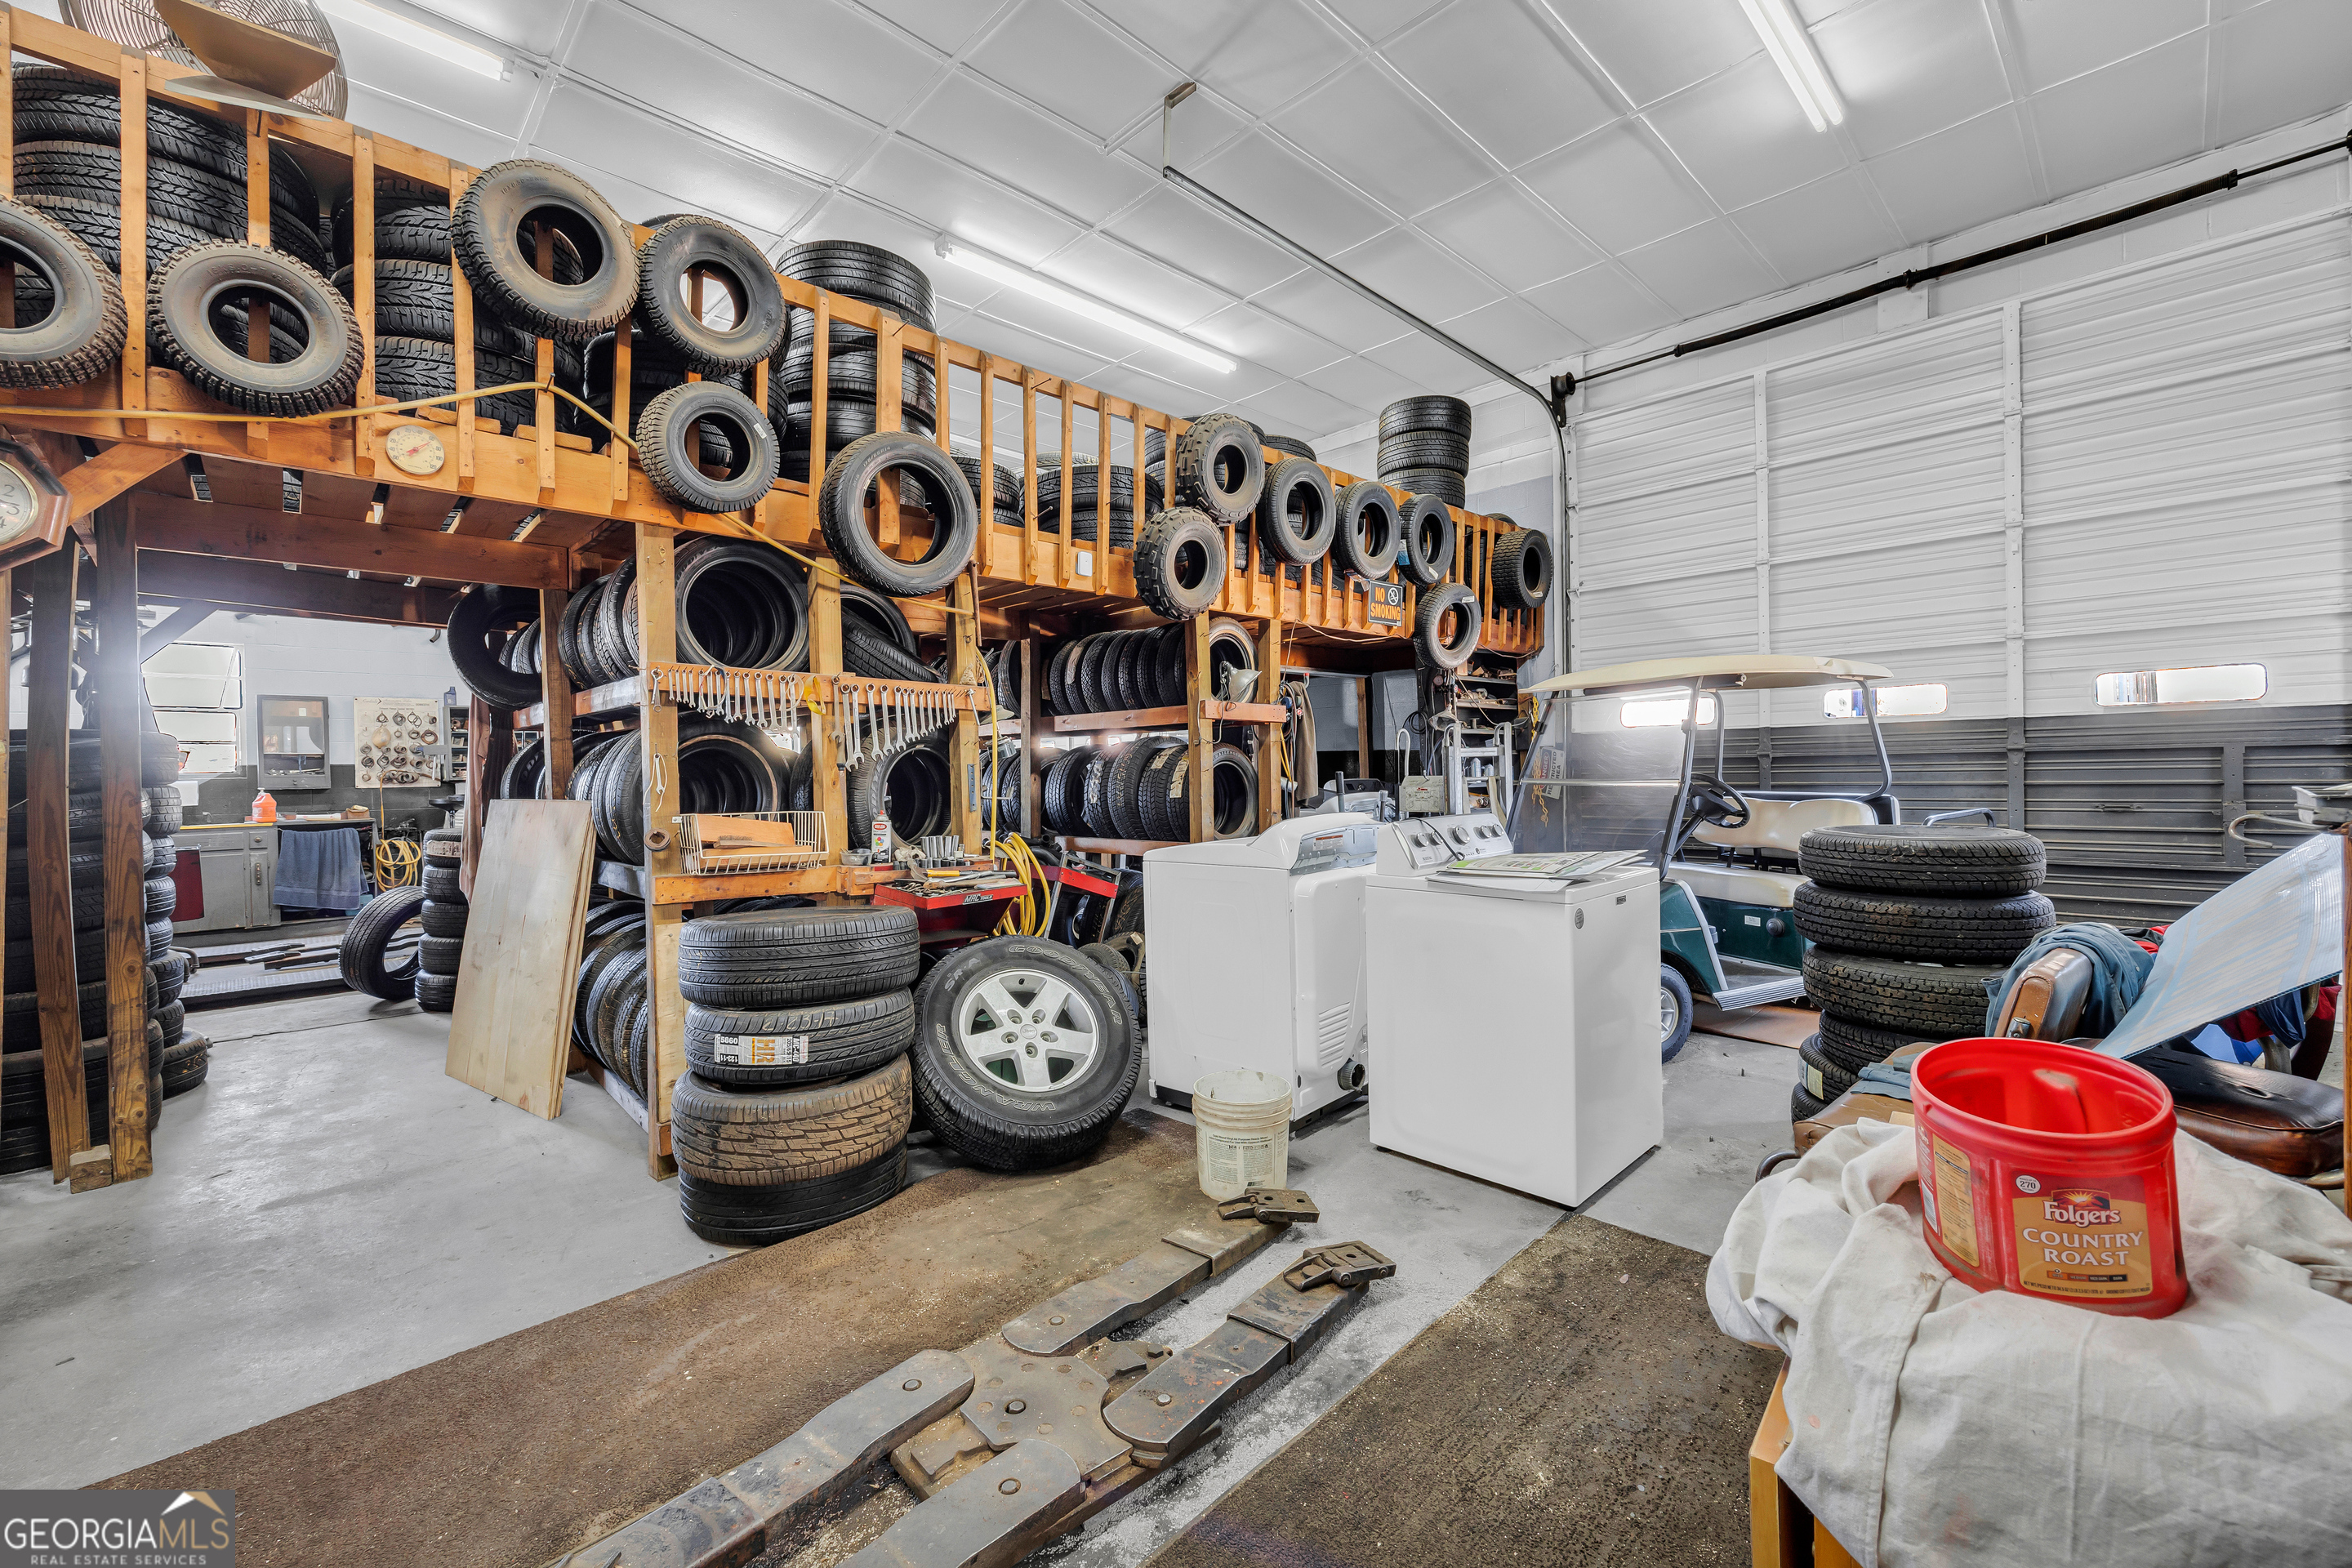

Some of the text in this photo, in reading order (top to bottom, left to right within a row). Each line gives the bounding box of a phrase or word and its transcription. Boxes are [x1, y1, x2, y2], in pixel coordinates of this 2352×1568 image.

[2, 484, 16, 497] 2
[1375, 586, 1385, 602] NO
[1371, 603, 1401, 620] SMOKING
[1539, 755, 1549, 780] ANGER
[1548, 751, 1557, 795] RETRICTED
[1009, 945, 1123, 1025] GOODYEAR
[720, 1036, 738, 1045] 5860
[720, 1054, 738, 1062] 123-11
[937, 1024, 1056, 1111] WRANGLER
[2020, 1180, 2036, 1189] 270
[2043, 1201, 2121, 1227] Folgers
[2023, 1228, 2144, 1249] COUNTRY
[2043, 1248, 2129, 1266] ROAST
